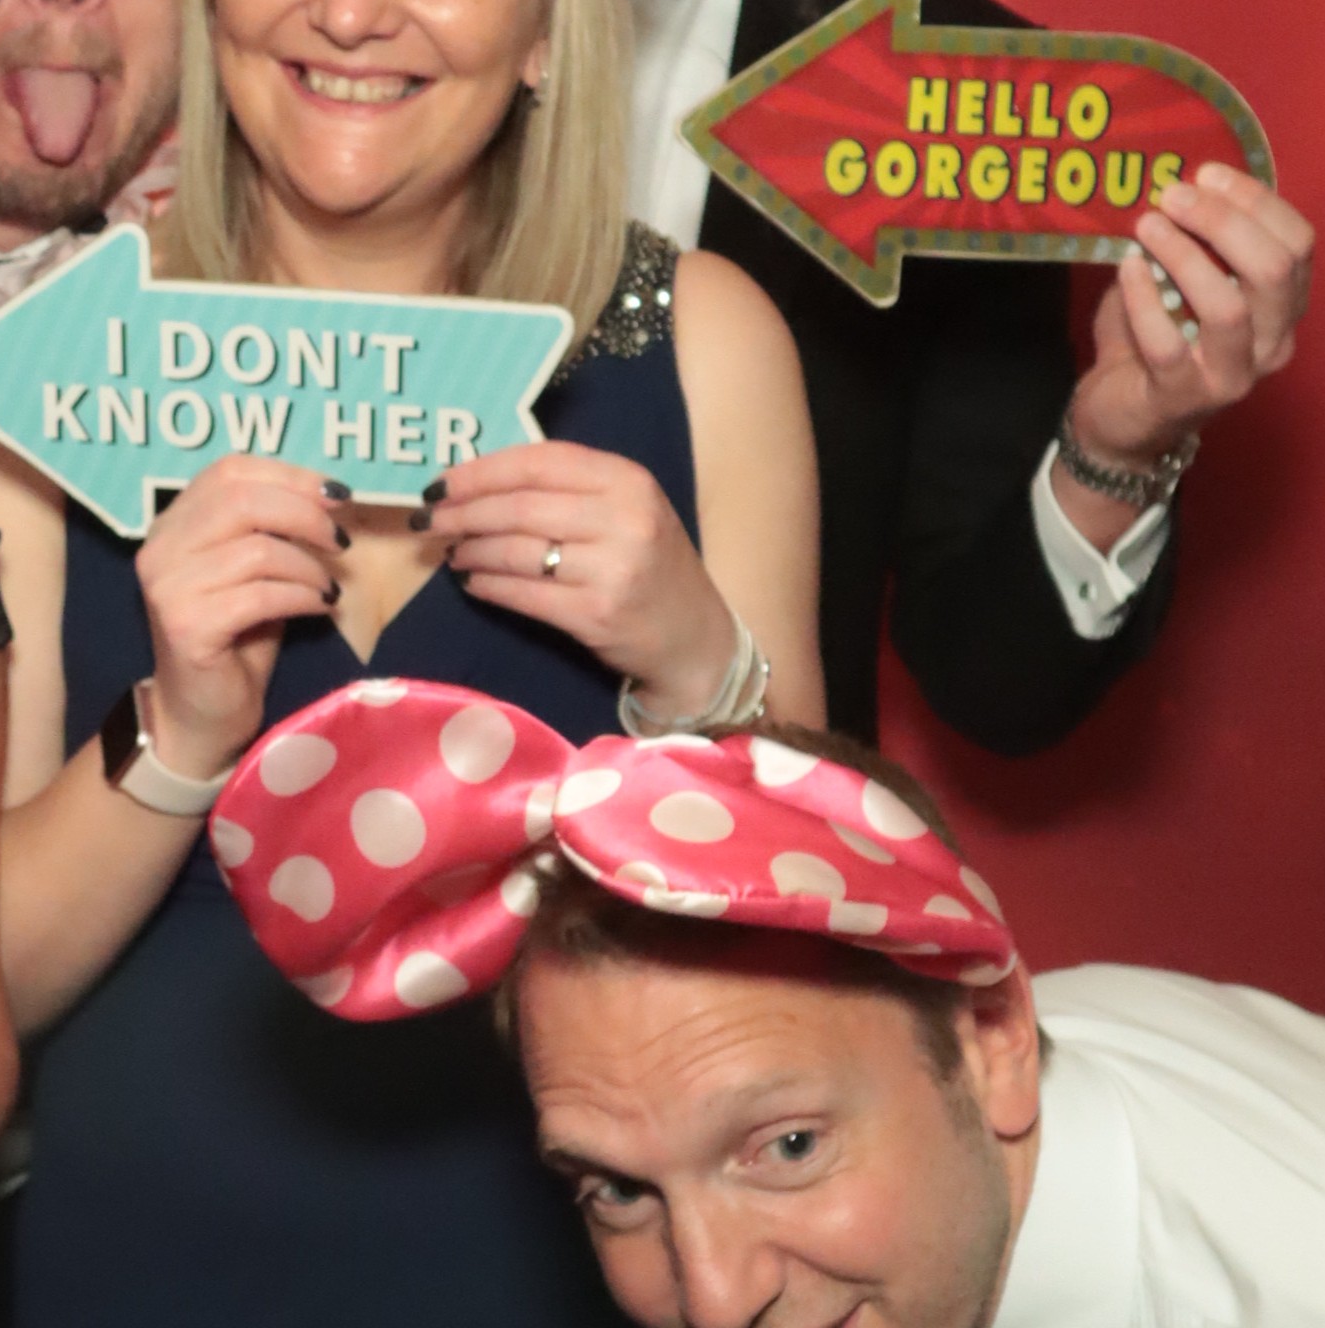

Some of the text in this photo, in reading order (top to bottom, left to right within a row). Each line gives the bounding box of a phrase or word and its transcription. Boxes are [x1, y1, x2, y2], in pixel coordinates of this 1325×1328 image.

[906, 76, 1110, 141] HELLO
[824, 138, 1183, 207] GORGEOUS
[106, 317, 416, 393] I DON'T
[42, 382, 482, 466] KNOW HER
